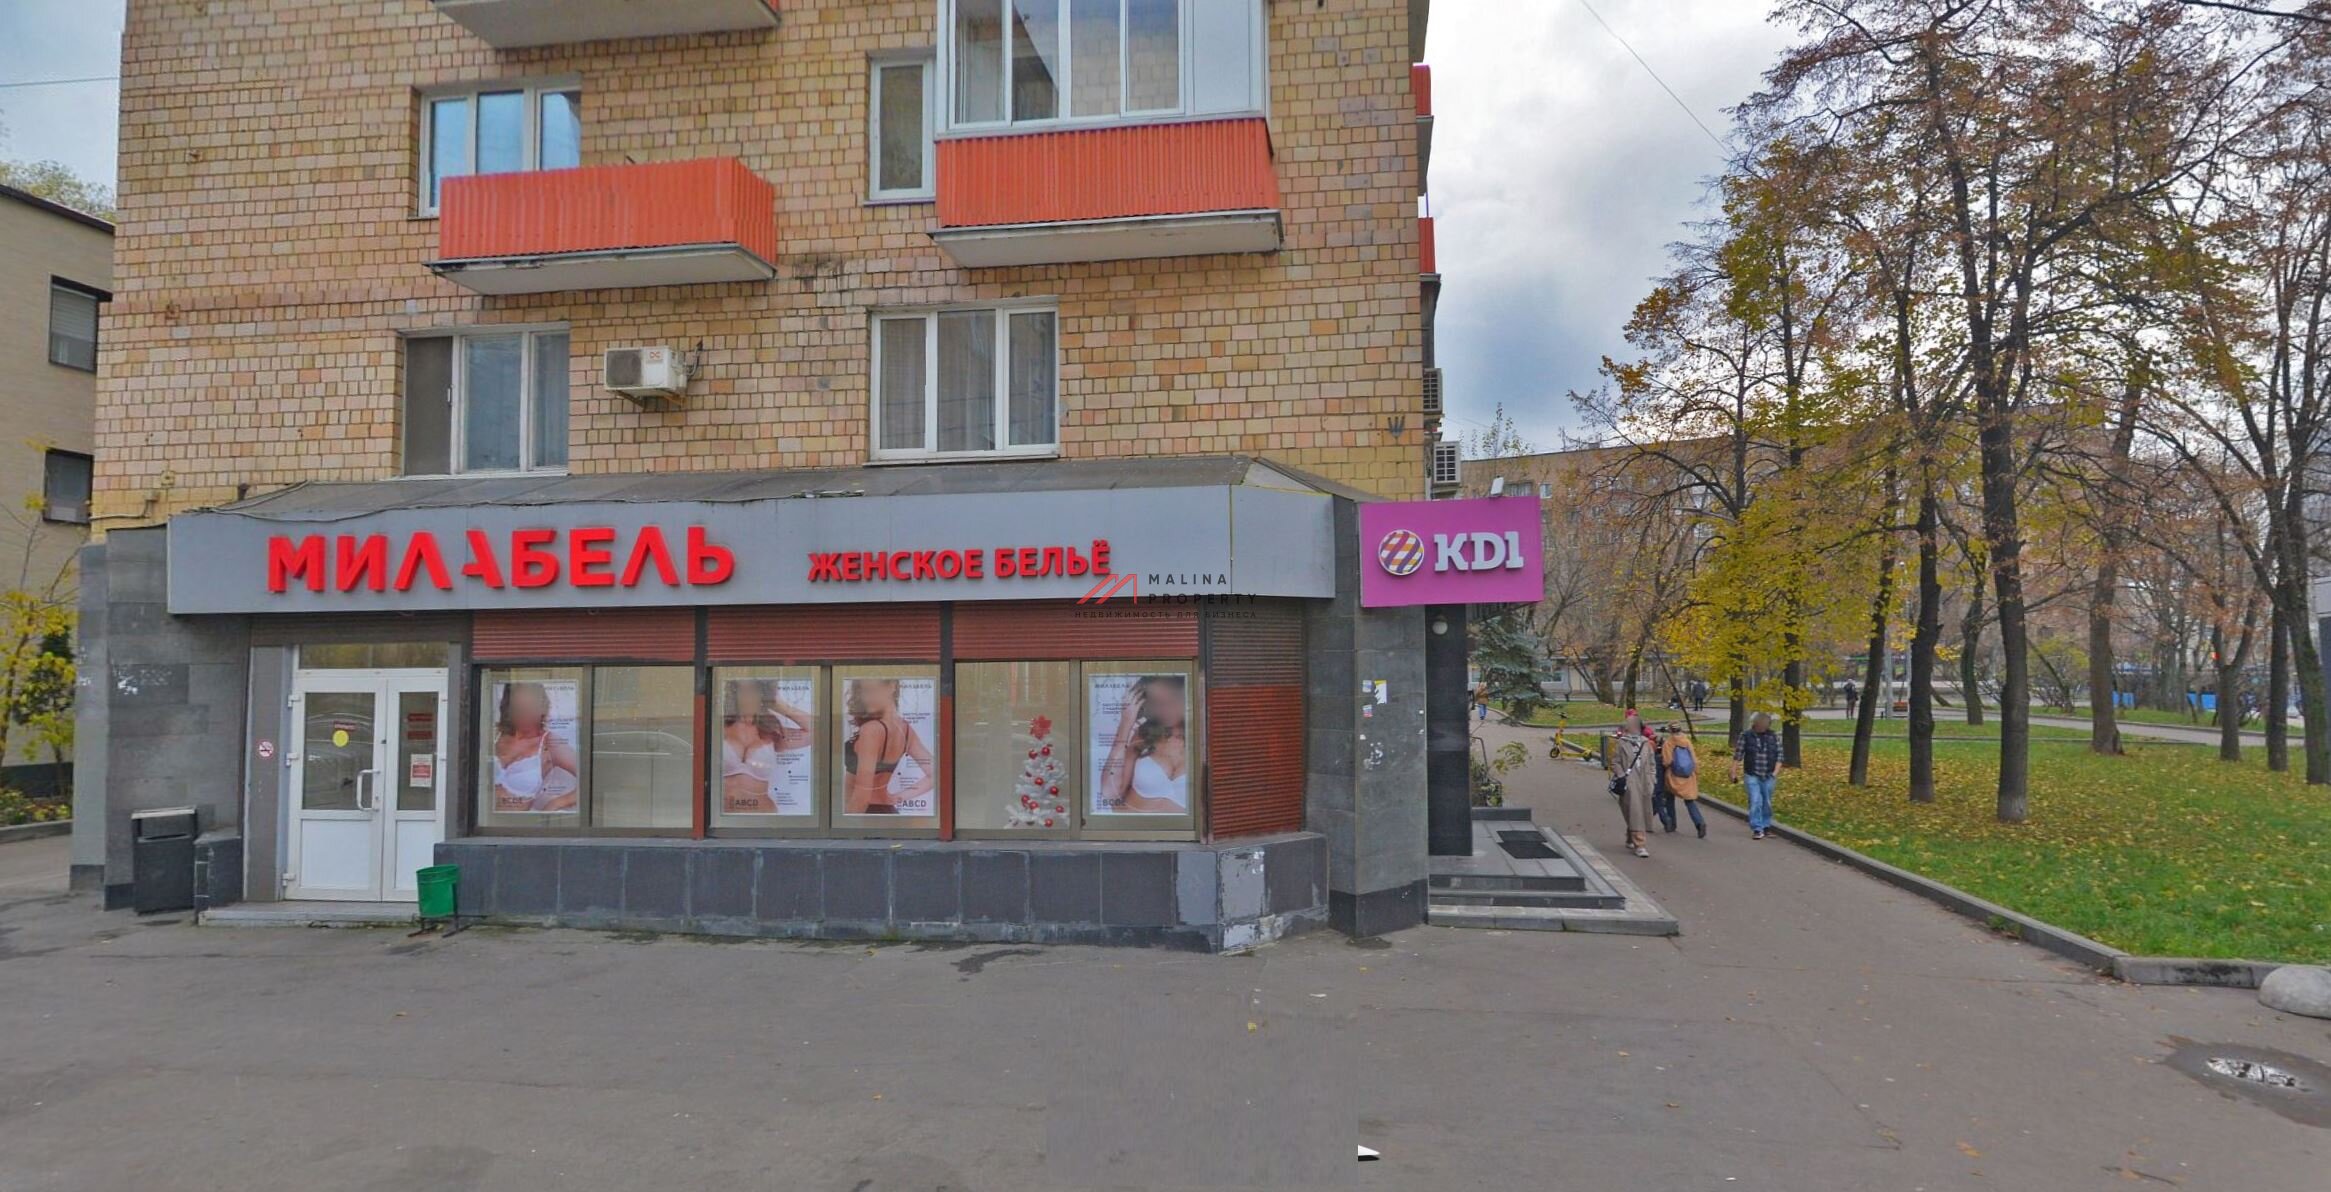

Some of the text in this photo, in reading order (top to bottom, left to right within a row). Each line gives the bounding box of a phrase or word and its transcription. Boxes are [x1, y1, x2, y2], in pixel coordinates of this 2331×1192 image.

[267, 525, 736, 593] МИЛАБЕЛЬ
[807, 539, 1111, 582] ЖЕНСКОЕ БЕЛЬЁ
[902, 799, 927, 808] ABCD
